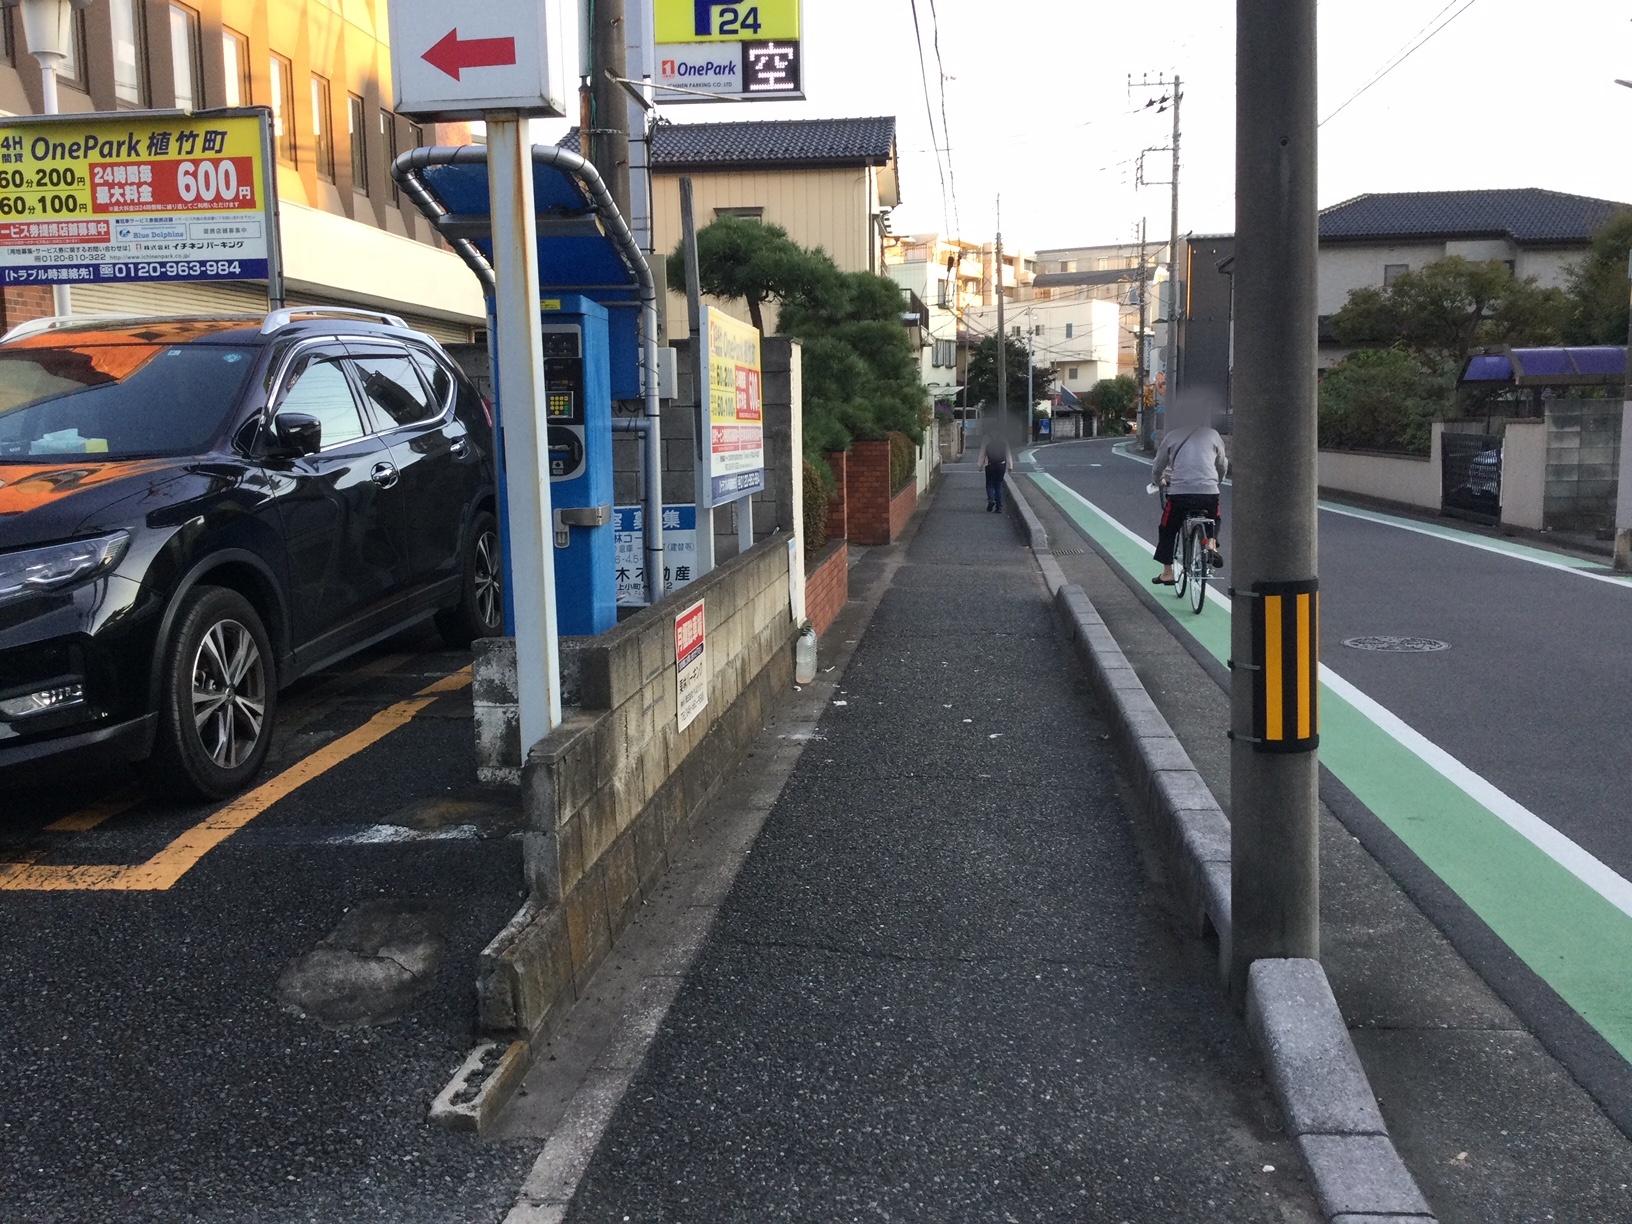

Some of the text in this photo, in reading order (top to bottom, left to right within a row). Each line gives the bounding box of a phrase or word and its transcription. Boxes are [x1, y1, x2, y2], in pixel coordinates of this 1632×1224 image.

[719, 7, 761, 35] 24
[677, 60, 736, 76] OnePark
[750, 43, 794, 90] 空
[31, 131, 228, 162] OnePark 植竹町
[95, 184, 154, 205] 最大料金
[133, 231, 151, 240] Blue
[114, 261, 241, 278] 0120-963-984
